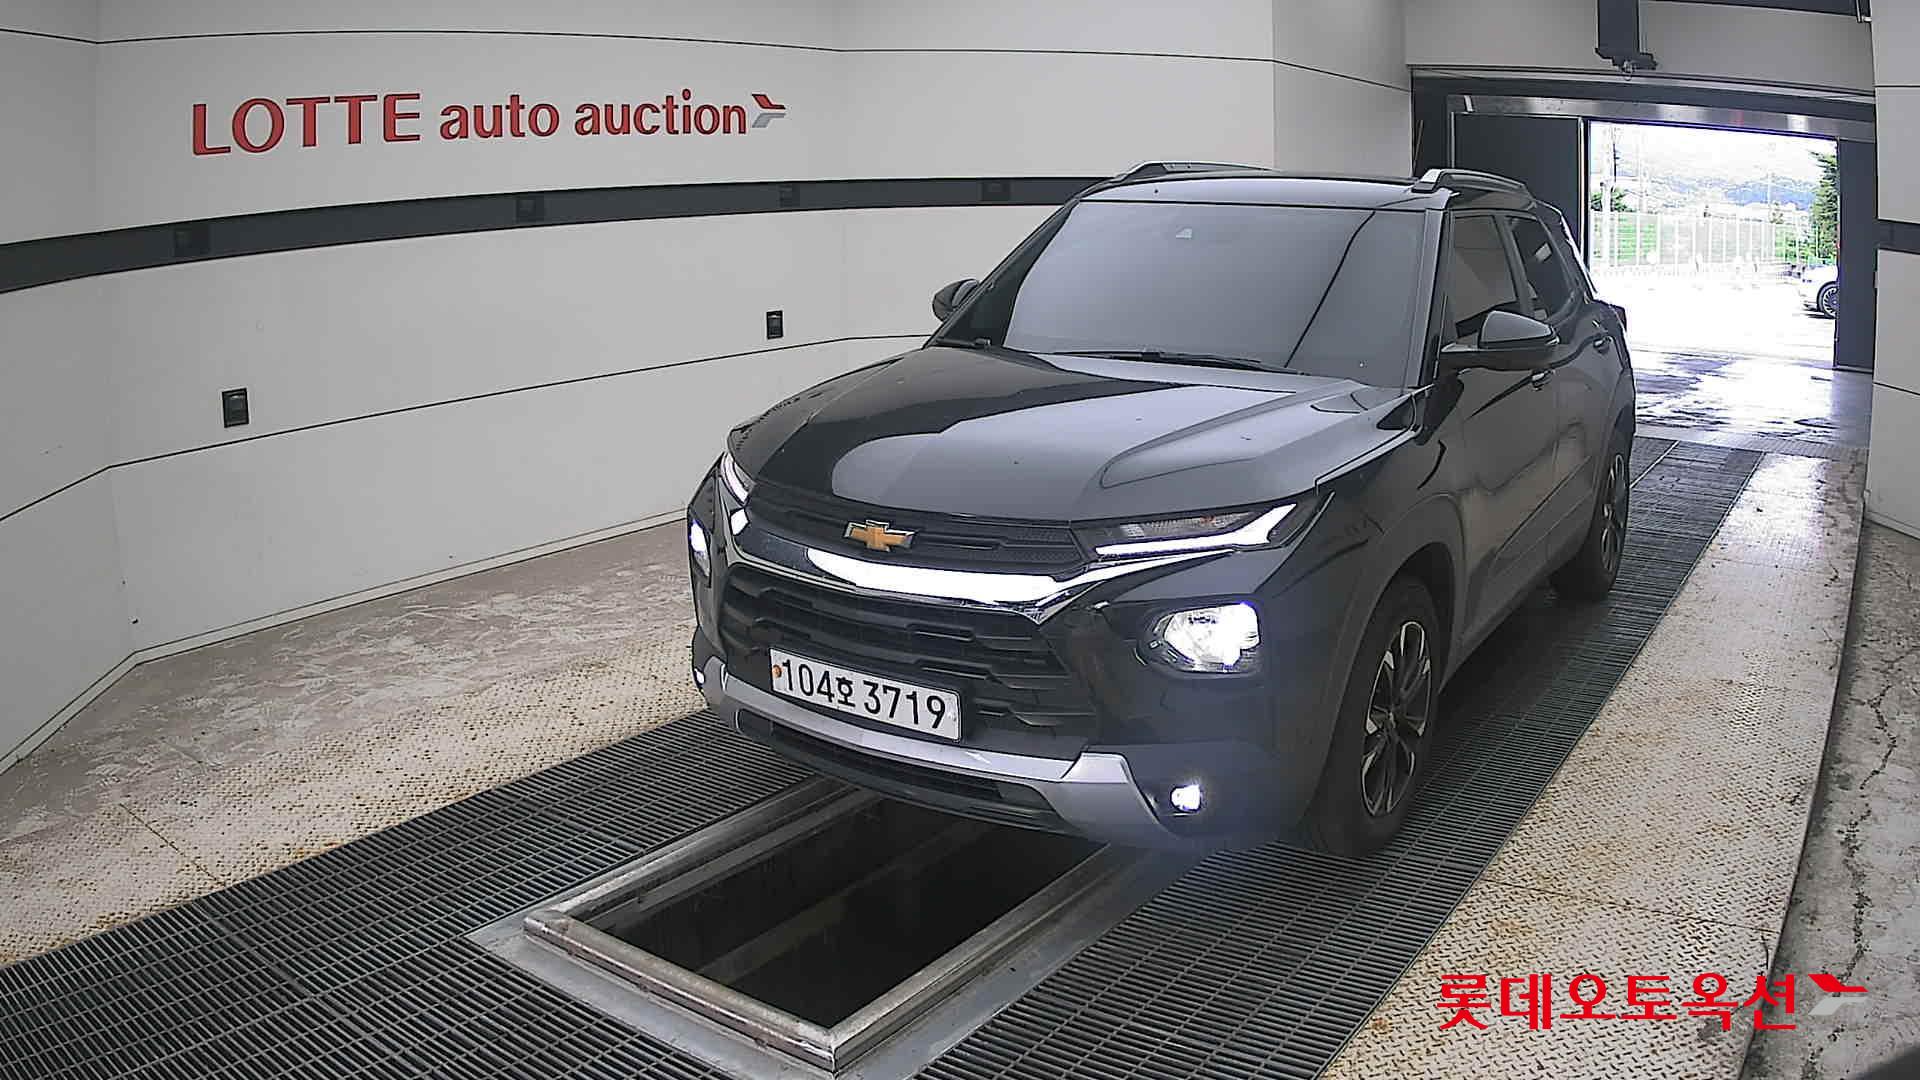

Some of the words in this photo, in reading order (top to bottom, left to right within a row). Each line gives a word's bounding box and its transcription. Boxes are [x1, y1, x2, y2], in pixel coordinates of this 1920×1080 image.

[193, 93, 420, 155] LOTTE
[439, 94, 560, 140] auto
[574, 89, 747, 136] auction
[782, 659, 856, 707] 104호
[863, 680, 946, 729] 3719
